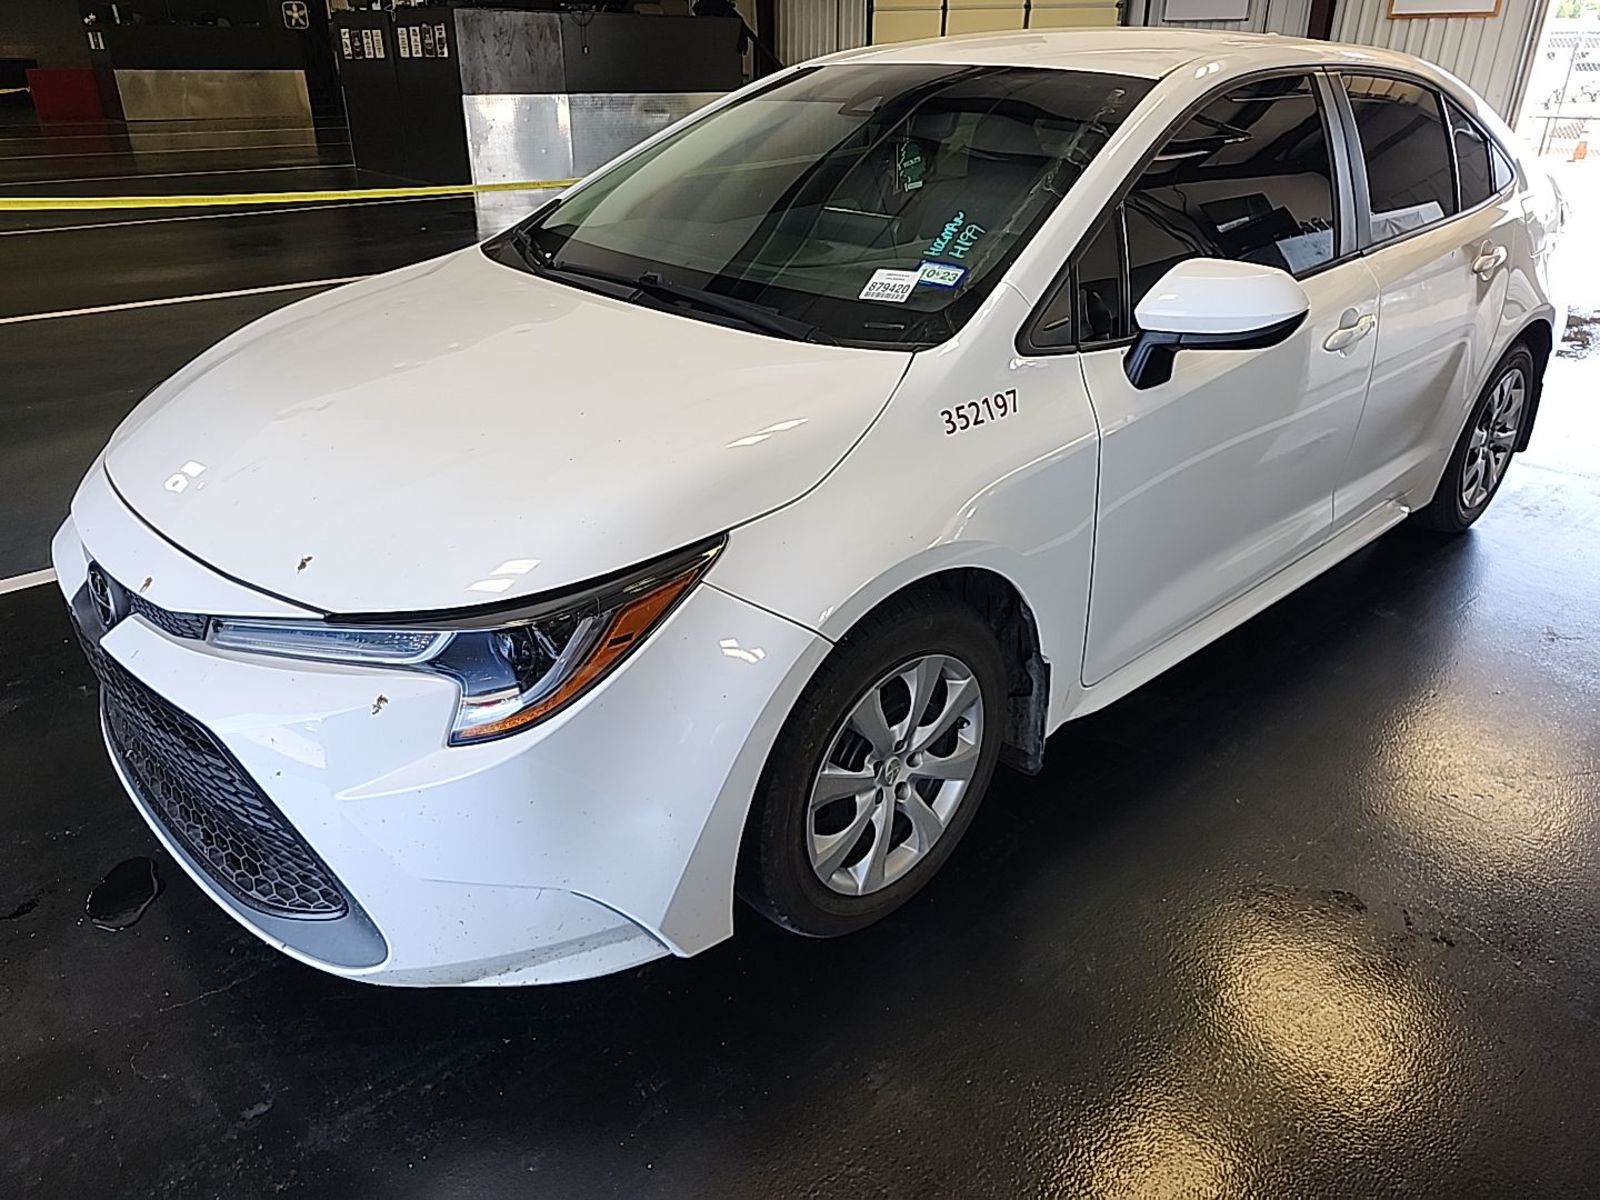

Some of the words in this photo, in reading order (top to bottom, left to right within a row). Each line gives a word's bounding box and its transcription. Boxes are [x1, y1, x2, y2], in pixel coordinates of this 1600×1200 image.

[920, 268, 937, 279] 10
[940, 270, 958, 282] 23
[868, 281, 911, 295] 879420
[940, 388, 1017, 435] 352197
